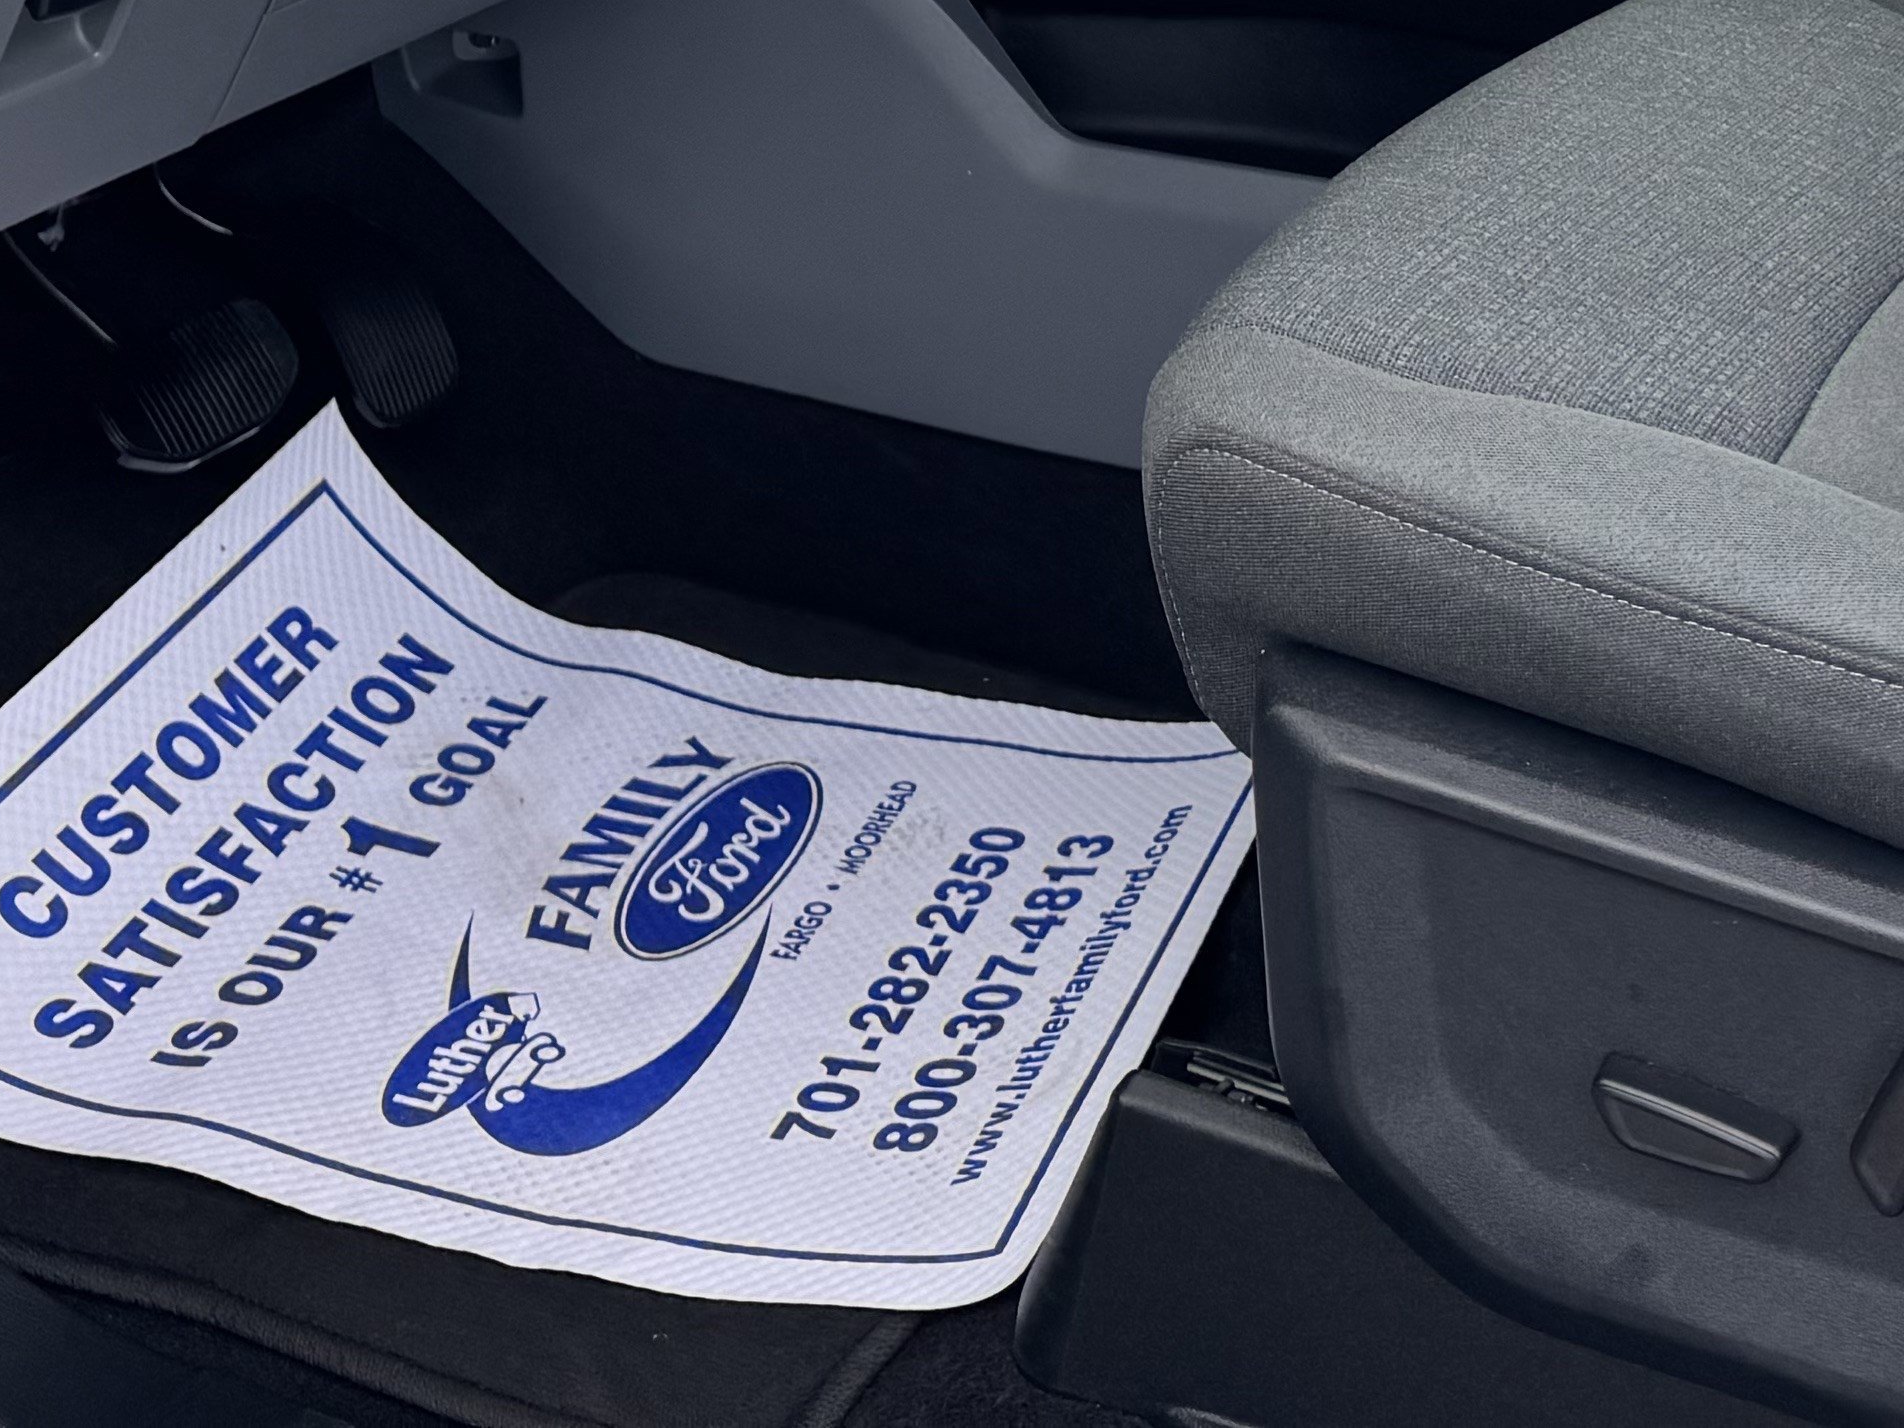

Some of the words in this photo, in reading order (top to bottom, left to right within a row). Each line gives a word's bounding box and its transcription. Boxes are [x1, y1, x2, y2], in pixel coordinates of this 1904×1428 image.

[34, 632, 455, 1049] SATISFACTION
[150, 1021, 238, 1067] IS
[218, 904, 353, 1005] OUR
[408, 696, 549, 806] GOAL
[525, 735, 734, 951] FAMILY
[648, 797, 792, 922] Ford
[770, 901, 833, 961] FARGO
[836, 779, 917, 876] MOORHEAD
[770, 826, 1026, 1141] 701-282-2350
[872, 834, 1115, 1153] 800-307-4813
[950, 804, 1193, 1187] www.lutherfamilyford.com
[392, 1003, 515, 1113] Luther
